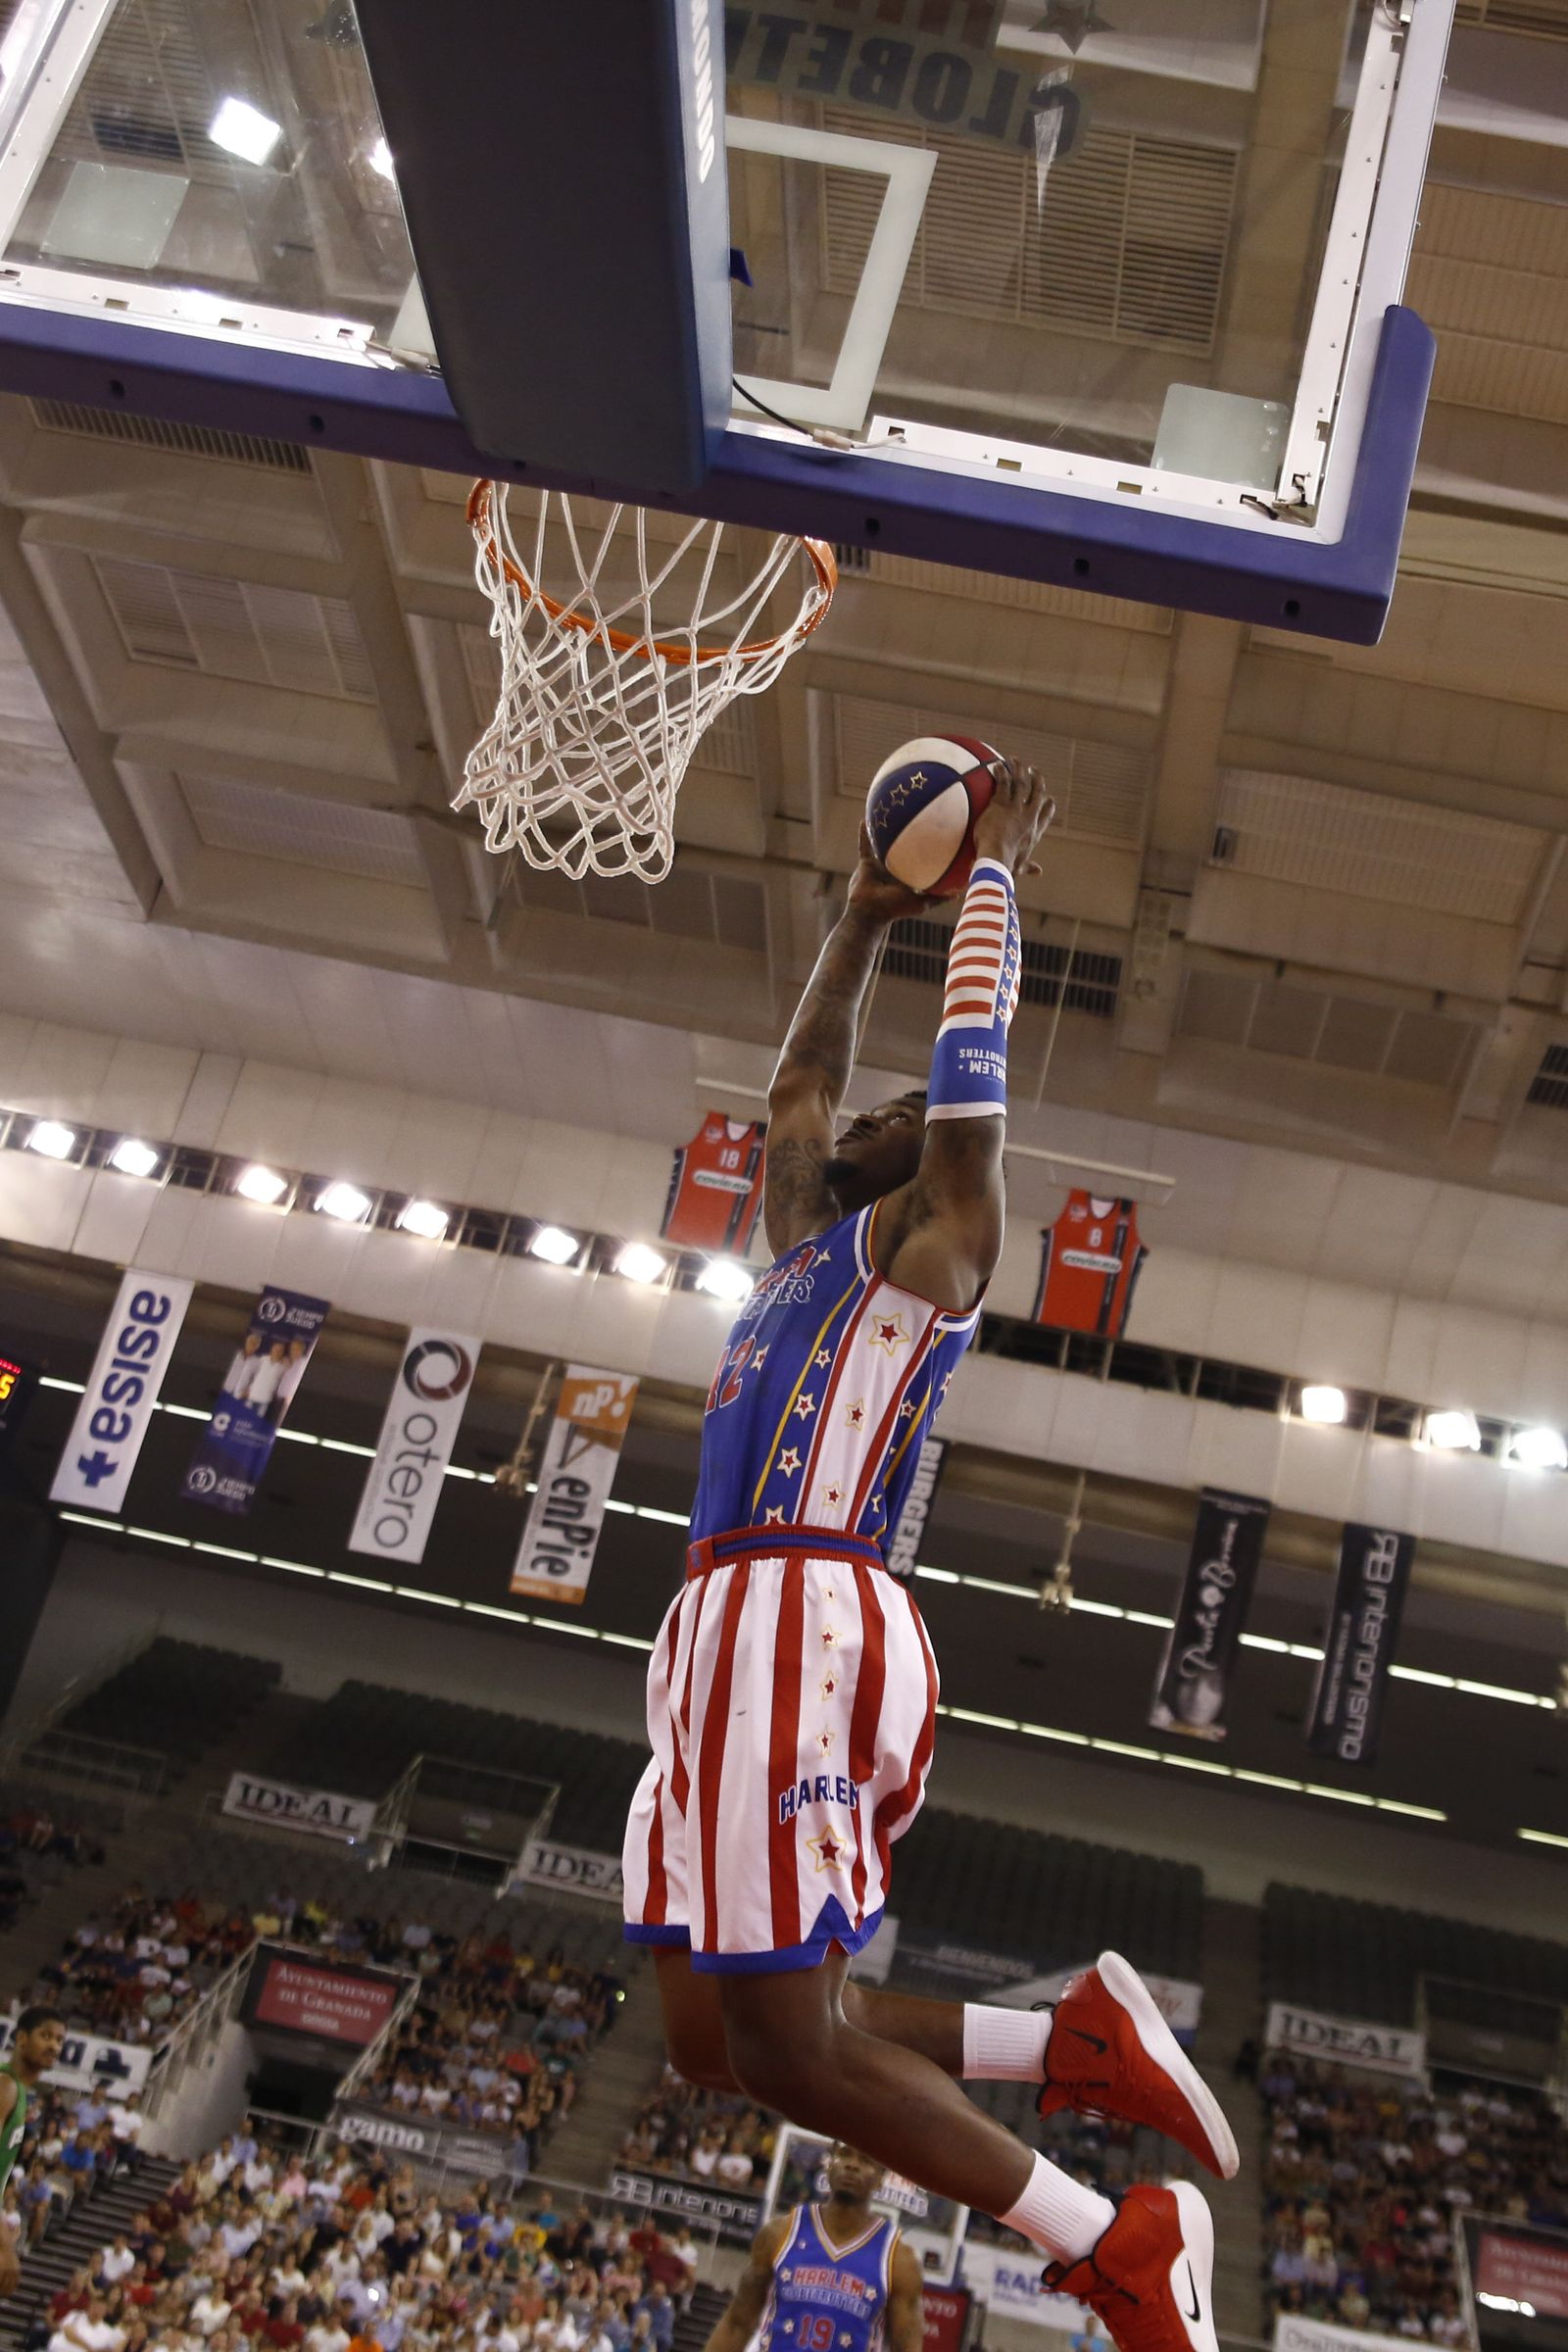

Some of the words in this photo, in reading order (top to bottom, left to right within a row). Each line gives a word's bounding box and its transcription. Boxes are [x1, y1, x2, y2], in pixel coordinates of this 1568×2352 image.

[958, 1048, 1007, 1067] TROTTERS
[719, 1148, 741, 1169] 18
[1089, 1227, 1102, 1248] 8
[89, 1290, 172, 1444] asisa
[705, 1334, 757, 1416] 12
[374, 1413, 439, 1548] otero
[530, 1475, 598, 1577] enPie
[888, 1440, 944, 1575] BURGERS
[239, 1782, 361, 1831] IDEAL
[532, 1848, 624, 1895] IDEA
[1282, 2012, 1403, 2060] IDEAL
[340, 2117, 425, 2151] gamo
[794, 2267, 865, 2299] HARLEM
[799, 2315, 834, 2352] 19
